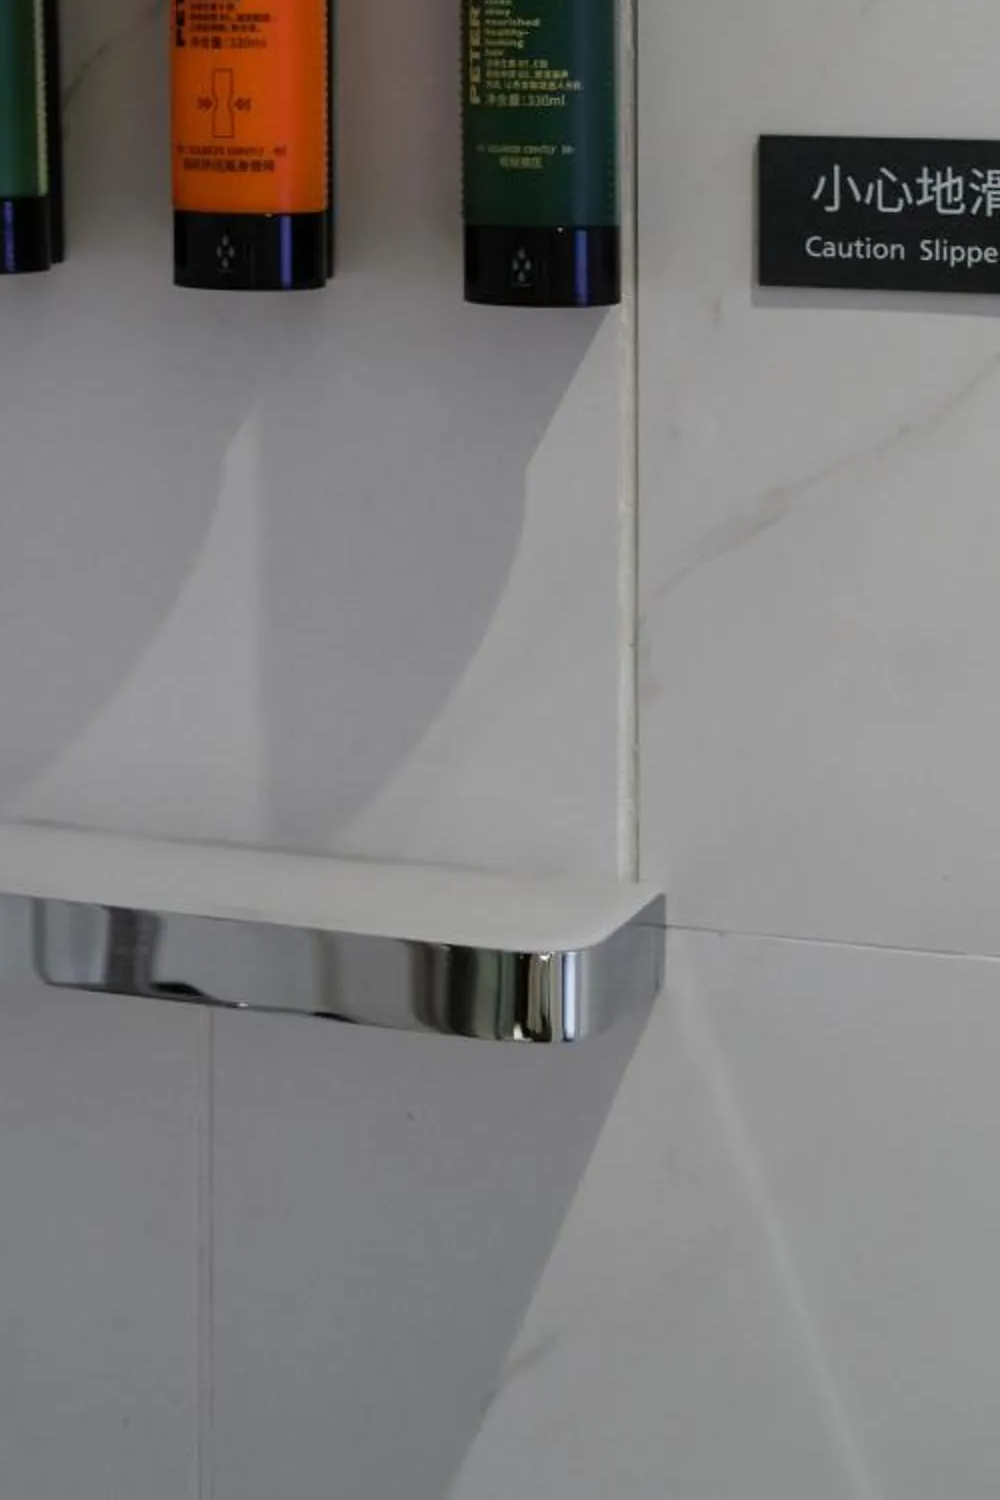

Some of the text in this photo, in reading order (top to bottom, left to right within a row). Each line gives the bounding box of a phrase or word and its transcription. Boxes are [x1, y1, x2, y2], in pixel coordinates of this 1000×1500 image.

[811, 163, 1000, 218] 小心地滑
[805, 236, 1000, 268] Caution Slippe
